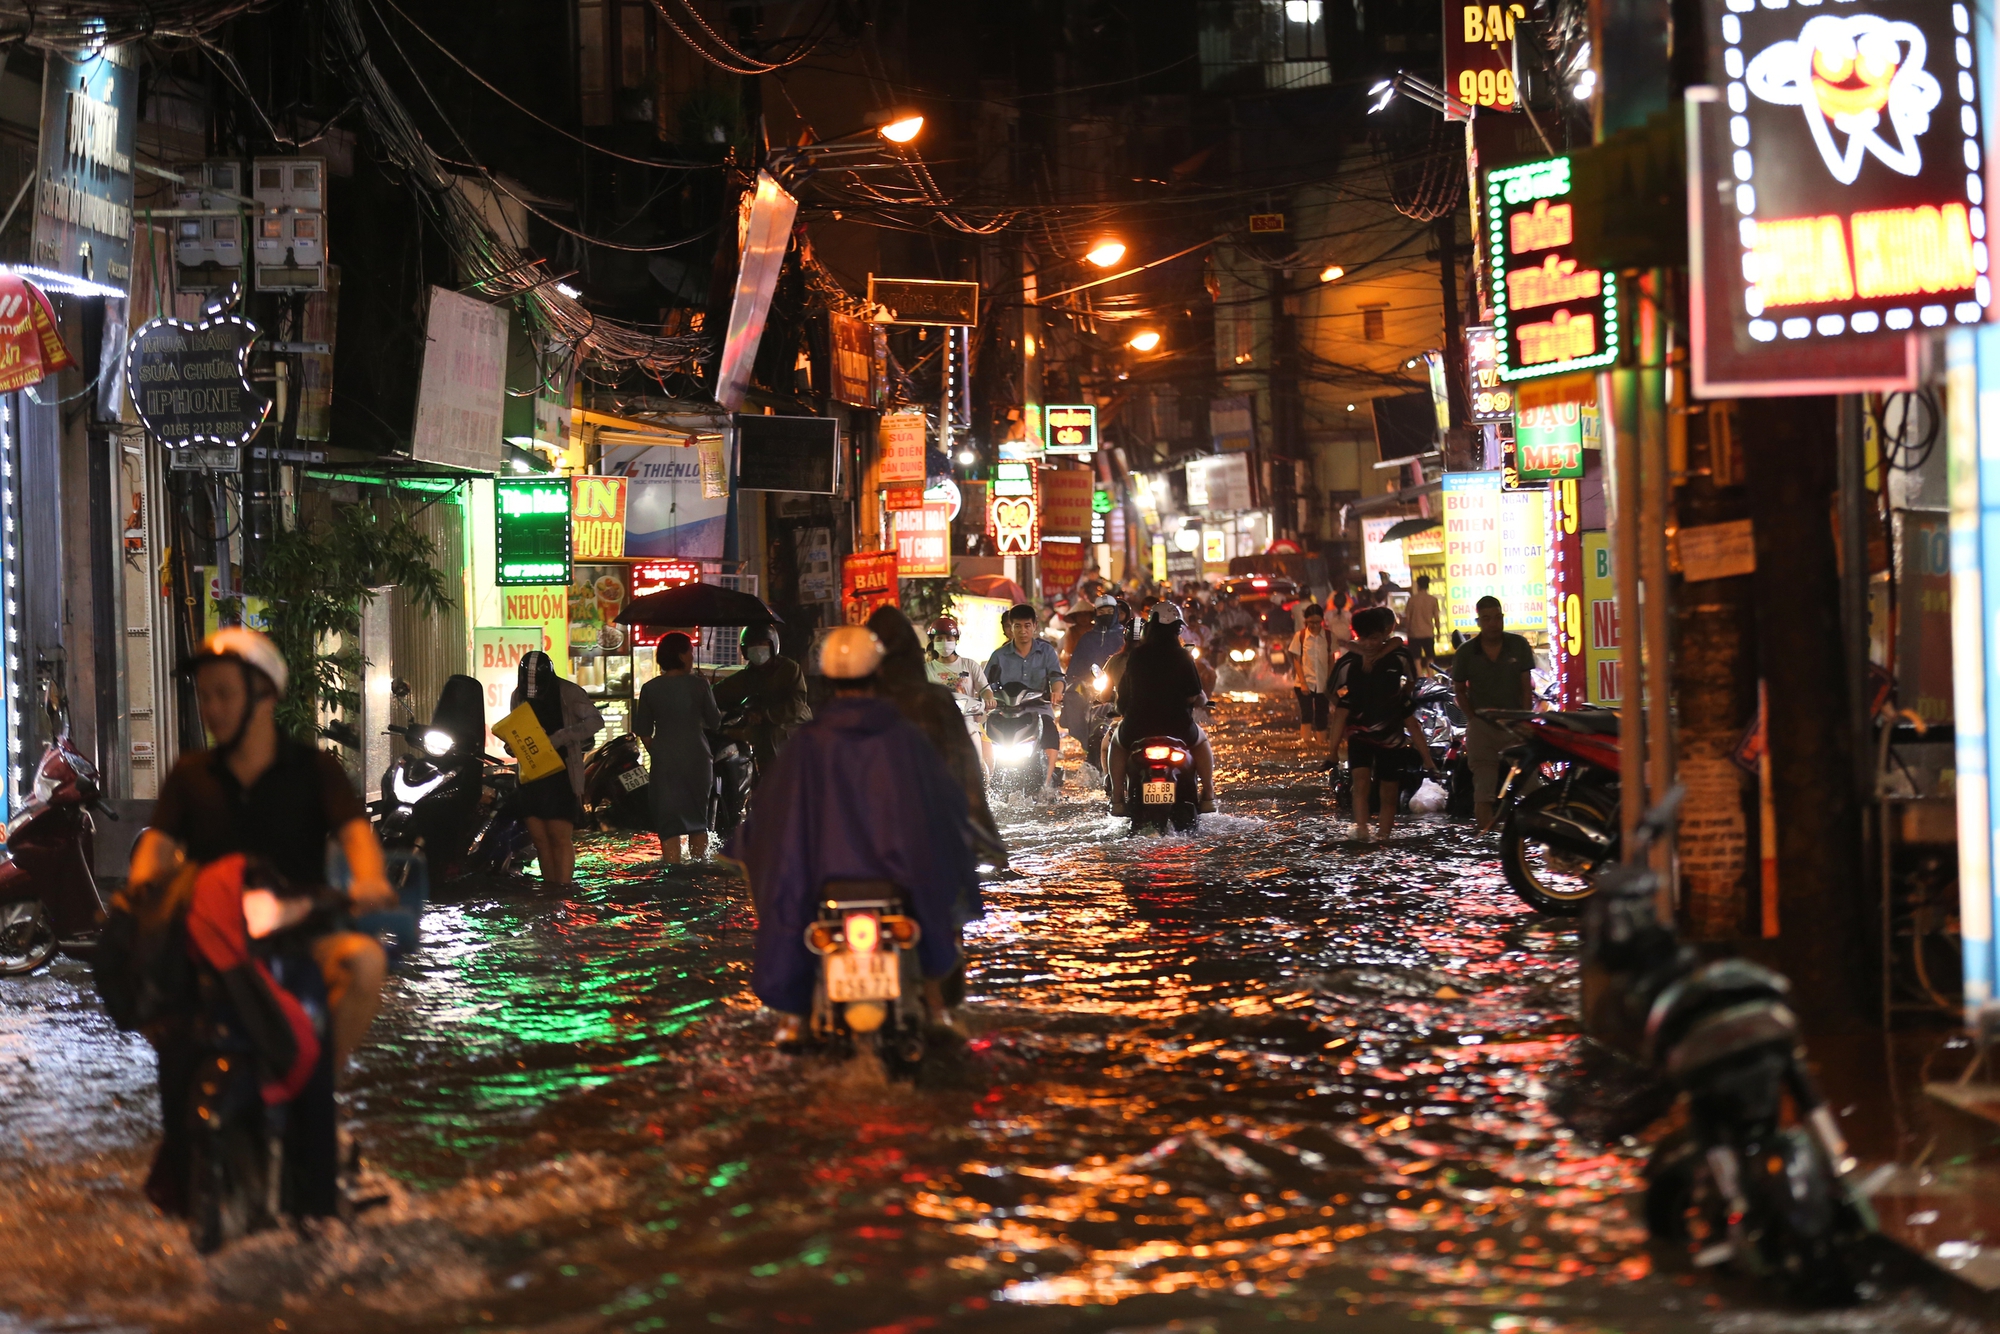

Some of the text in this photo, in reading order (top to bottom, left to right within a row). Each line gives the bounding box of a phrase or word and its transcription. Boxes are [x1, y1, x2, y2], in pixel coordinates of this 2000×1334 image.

[1459, 68, 1516, 106] 999
[1851, 203, 1977, 297] KHOA
[142, 330, 232, 353] MUA BÁN
[138, 358, 238, 382] SỬA CHỮA
[147, 387, 241, 415] IPHONE
[162, 421, 244, 436] 0165 212 8888
[1521, 442, 1582, 476] MẸT
[575, 479, 619, 518] IN
[855, 571, 887, 589] BÁN
[506, 587, 564, 625] NHUỘM
[483, 637, 535, 668] BÁN
[520, 745, 537, 769] SHOES
[1145, 793, 1173, 803] 000.62
